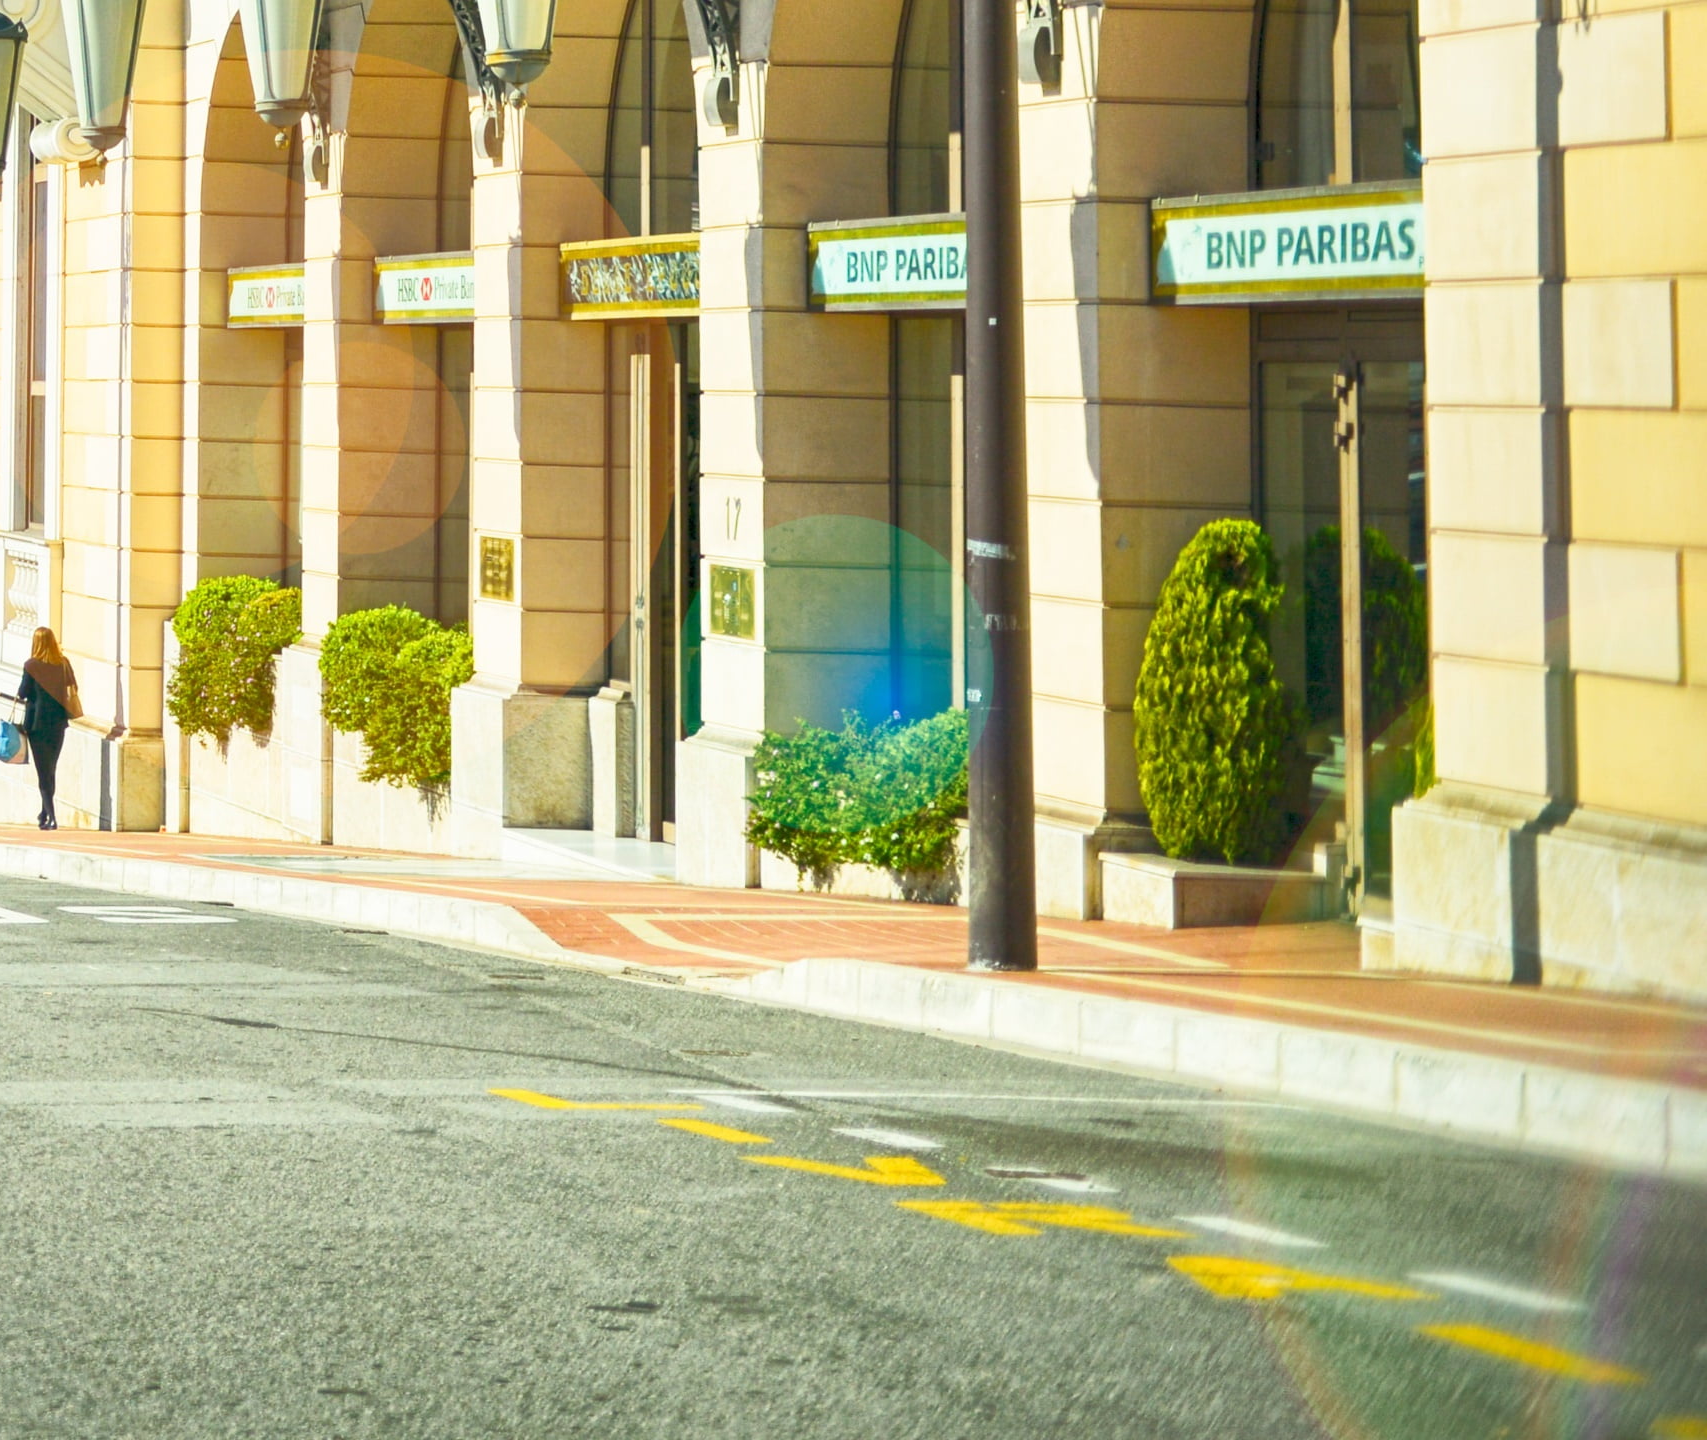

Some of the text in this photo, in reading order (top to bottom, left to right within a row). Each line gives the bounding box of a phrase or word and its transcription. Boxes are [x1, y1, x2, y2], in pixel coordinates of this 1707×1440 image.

[1207, 218, 1415, 270] BNP PARIBAS
[847, 249, 887, 283] BNP
[247, 286, 265, 309] HSBC
[276, 285, 296, 308] Private
[397, 278, 419, 303] HSBC
[434, 275, 459, 300] Private
